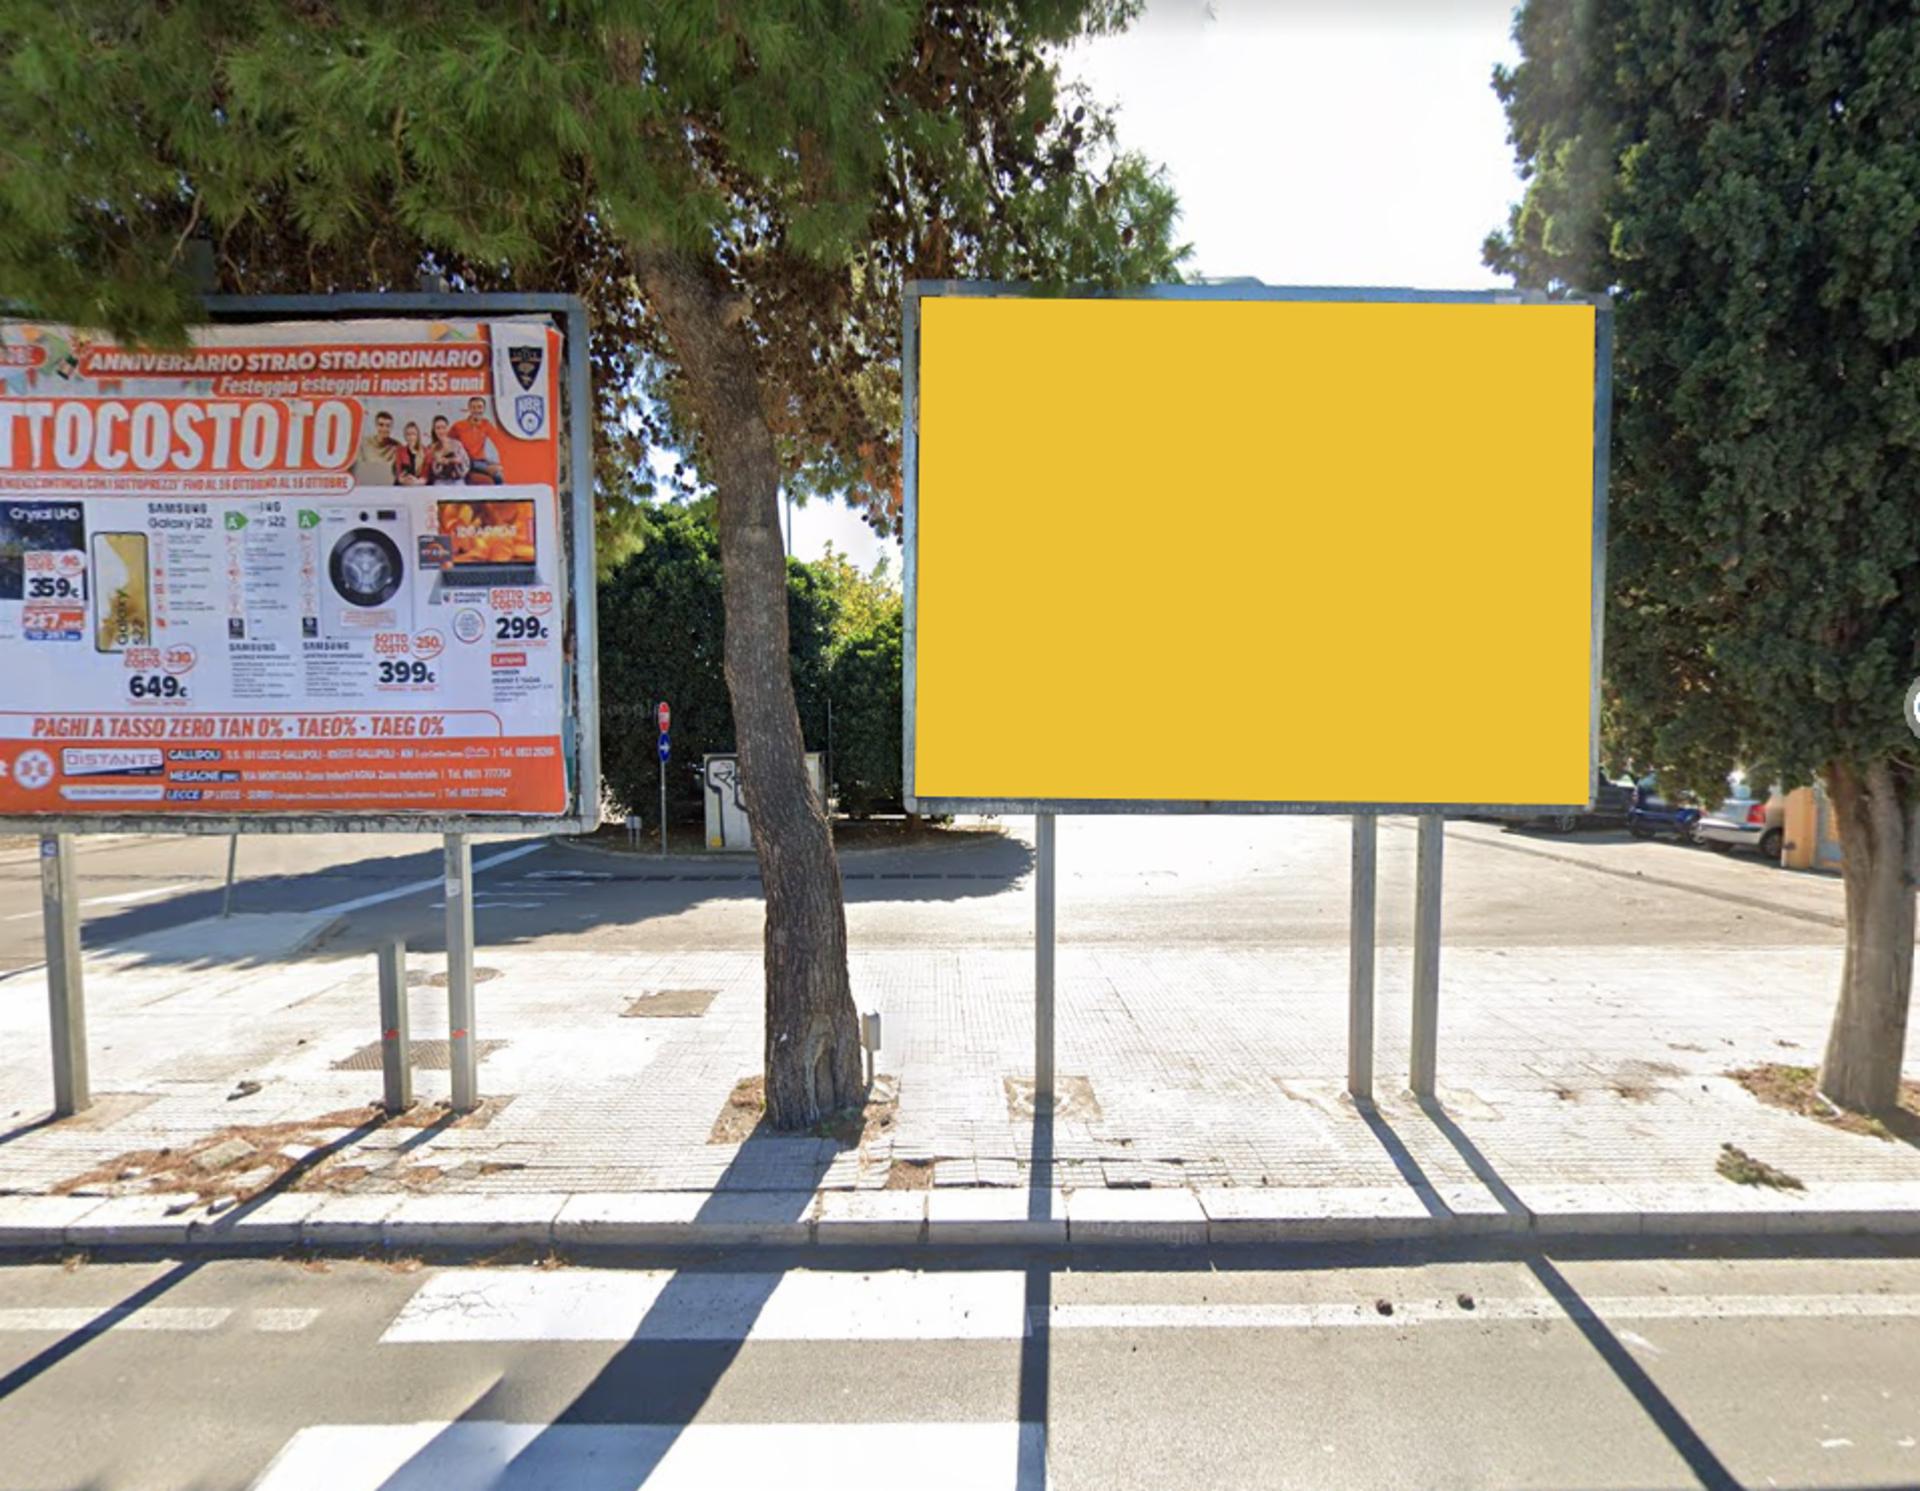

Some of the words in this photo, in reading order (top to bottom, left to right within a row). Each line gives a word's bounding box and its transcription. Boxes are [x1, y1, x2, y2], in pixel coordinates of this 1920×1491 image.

[246, 352, 316, 371] STRAO
[318, 349, 484, 370] STRAORDINARIO
[220, 376, 298, 396] Festeggia
[381, 373, 425, 392] nostri
[427, 372, 448, 392] 55
[450, 372, 485, 392] anni
[54, 508, 80, 520] UHD
[147, 502, 207, 514] SAMSUNG
[148, 517, 193, 531] Galaxy
[300, 514, 312, 528] A
[491, 590, 524, 600] SOTTO
[491, 599, 525, 610] COSTO
[374, 633, 409, 643] SOTTO
[229, 642, 276, 651] SAMSUNG
[302, 641, 350, 650] SAMSUNG
[373, 643, 410, 653] COSTO
[32, 717, 88, 738] PAGHI
[91, 717, 105, 738] A
[109, 717, 166, 738] TASSO
[168, 717, 216, 738] ZERO
[219, 717, 254, 738] TAN
[257, 717, 285, 738] 0%
[370, 715, 416, 737] TAEG
[418, 715, 446, 737] 0%
[66, 753, 161, 766] DISTANTE
